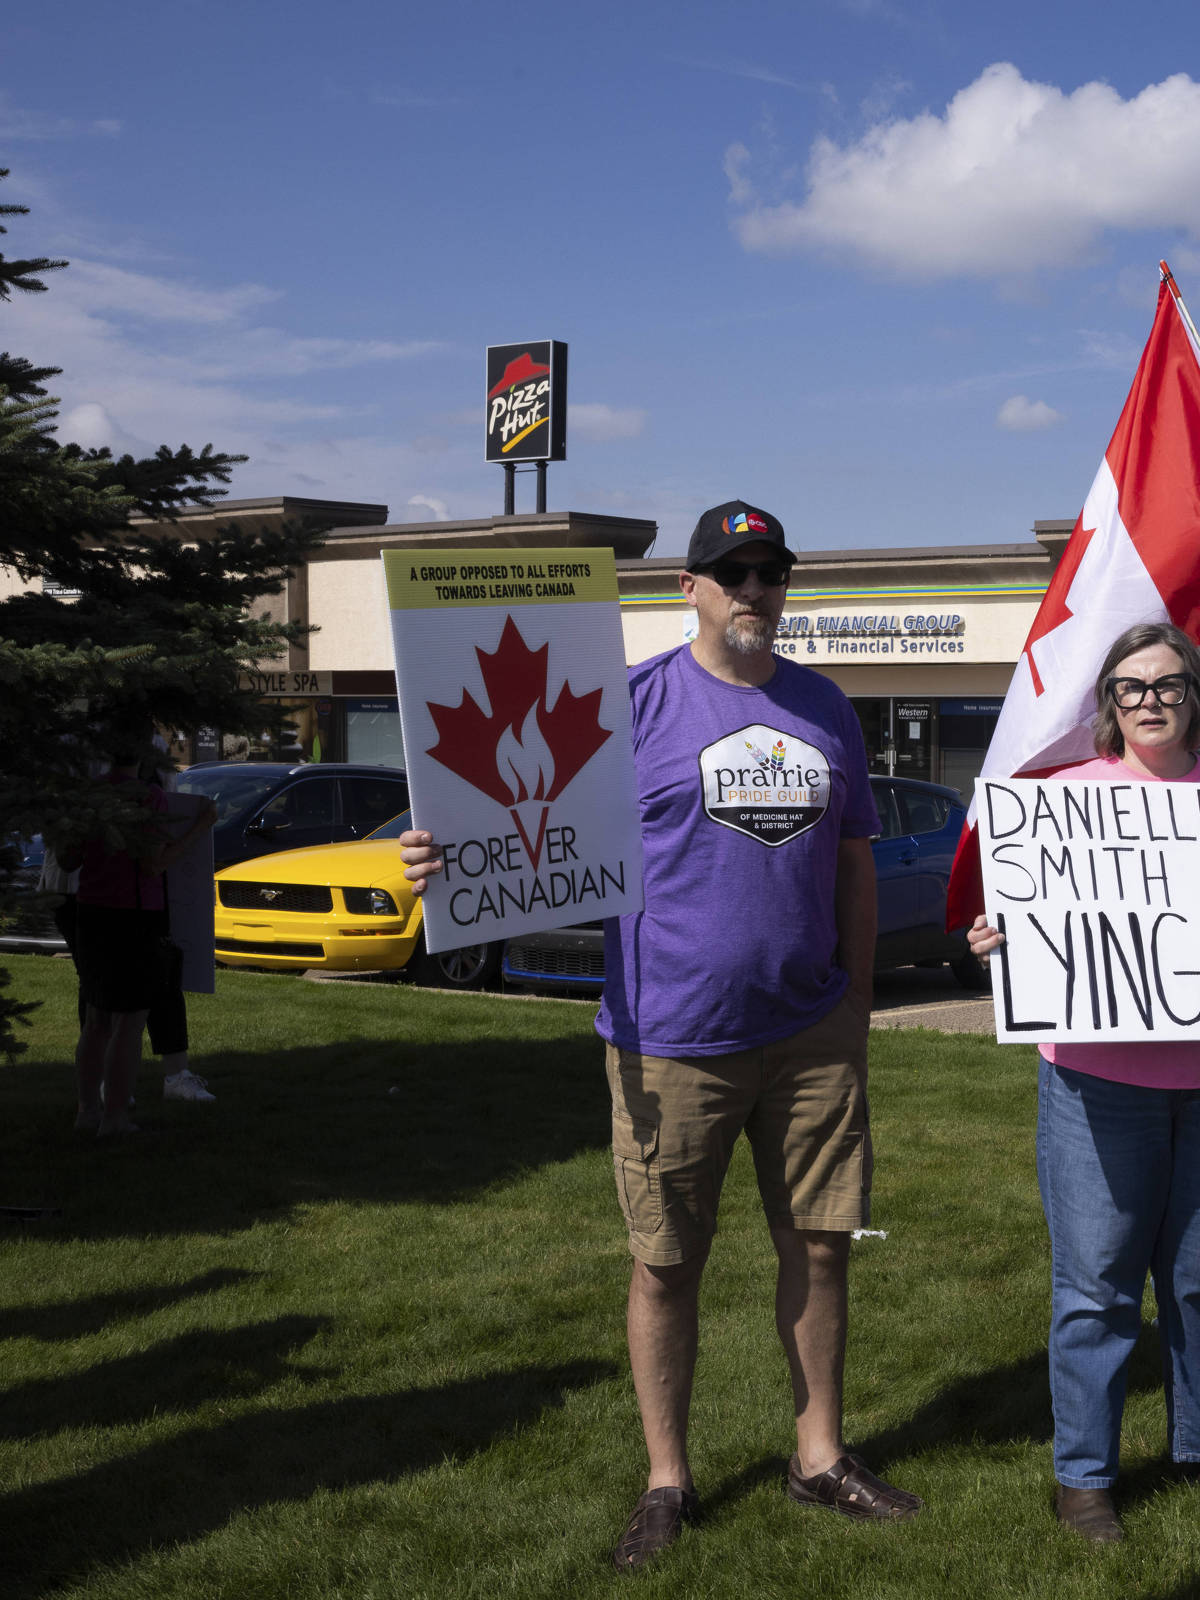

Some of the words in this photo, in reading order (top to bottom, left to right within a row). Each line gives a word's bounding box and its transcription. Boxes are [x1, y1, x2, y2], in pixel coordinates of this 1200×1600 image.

[489, 380, 550, 435] Pizza
[500, 401, 545, 442] Hut
[410, 567, 418, 581] A
[421, 566, 457, 581] GROUP
[460, 565, 508, 580] OPPOSED
[510, 564, 524, 579] TO
[528, 564, 545, 578] ALL
[548, 564, 591, 577] EFFORTS
[435, 584, 486, 600] TOWARDS
[490, 583, 533, 598] LEAVING
[535, 582, 576, 597] CANADA
[816, 615, 898, 631] FINANCIAL
[903, 614, 961, 630] GROUP
[807, 640, 816, 653] &
[828, 639, 894, 653] Financial
[901, 638, 965, 653] Services
[248, 674, 286, 692] STYLE
[294, 674, 320, 692] SPA
[714, 764, 821, 803] prairie
[728, 790, 771, 802] PRIDE
[777, 790, 819, 802] GUILD
[442, 806, 579, 881] FOREVER
[992, 843, 1171, 907] SMITH
[449, 861, 625, 926] CANADIAN
